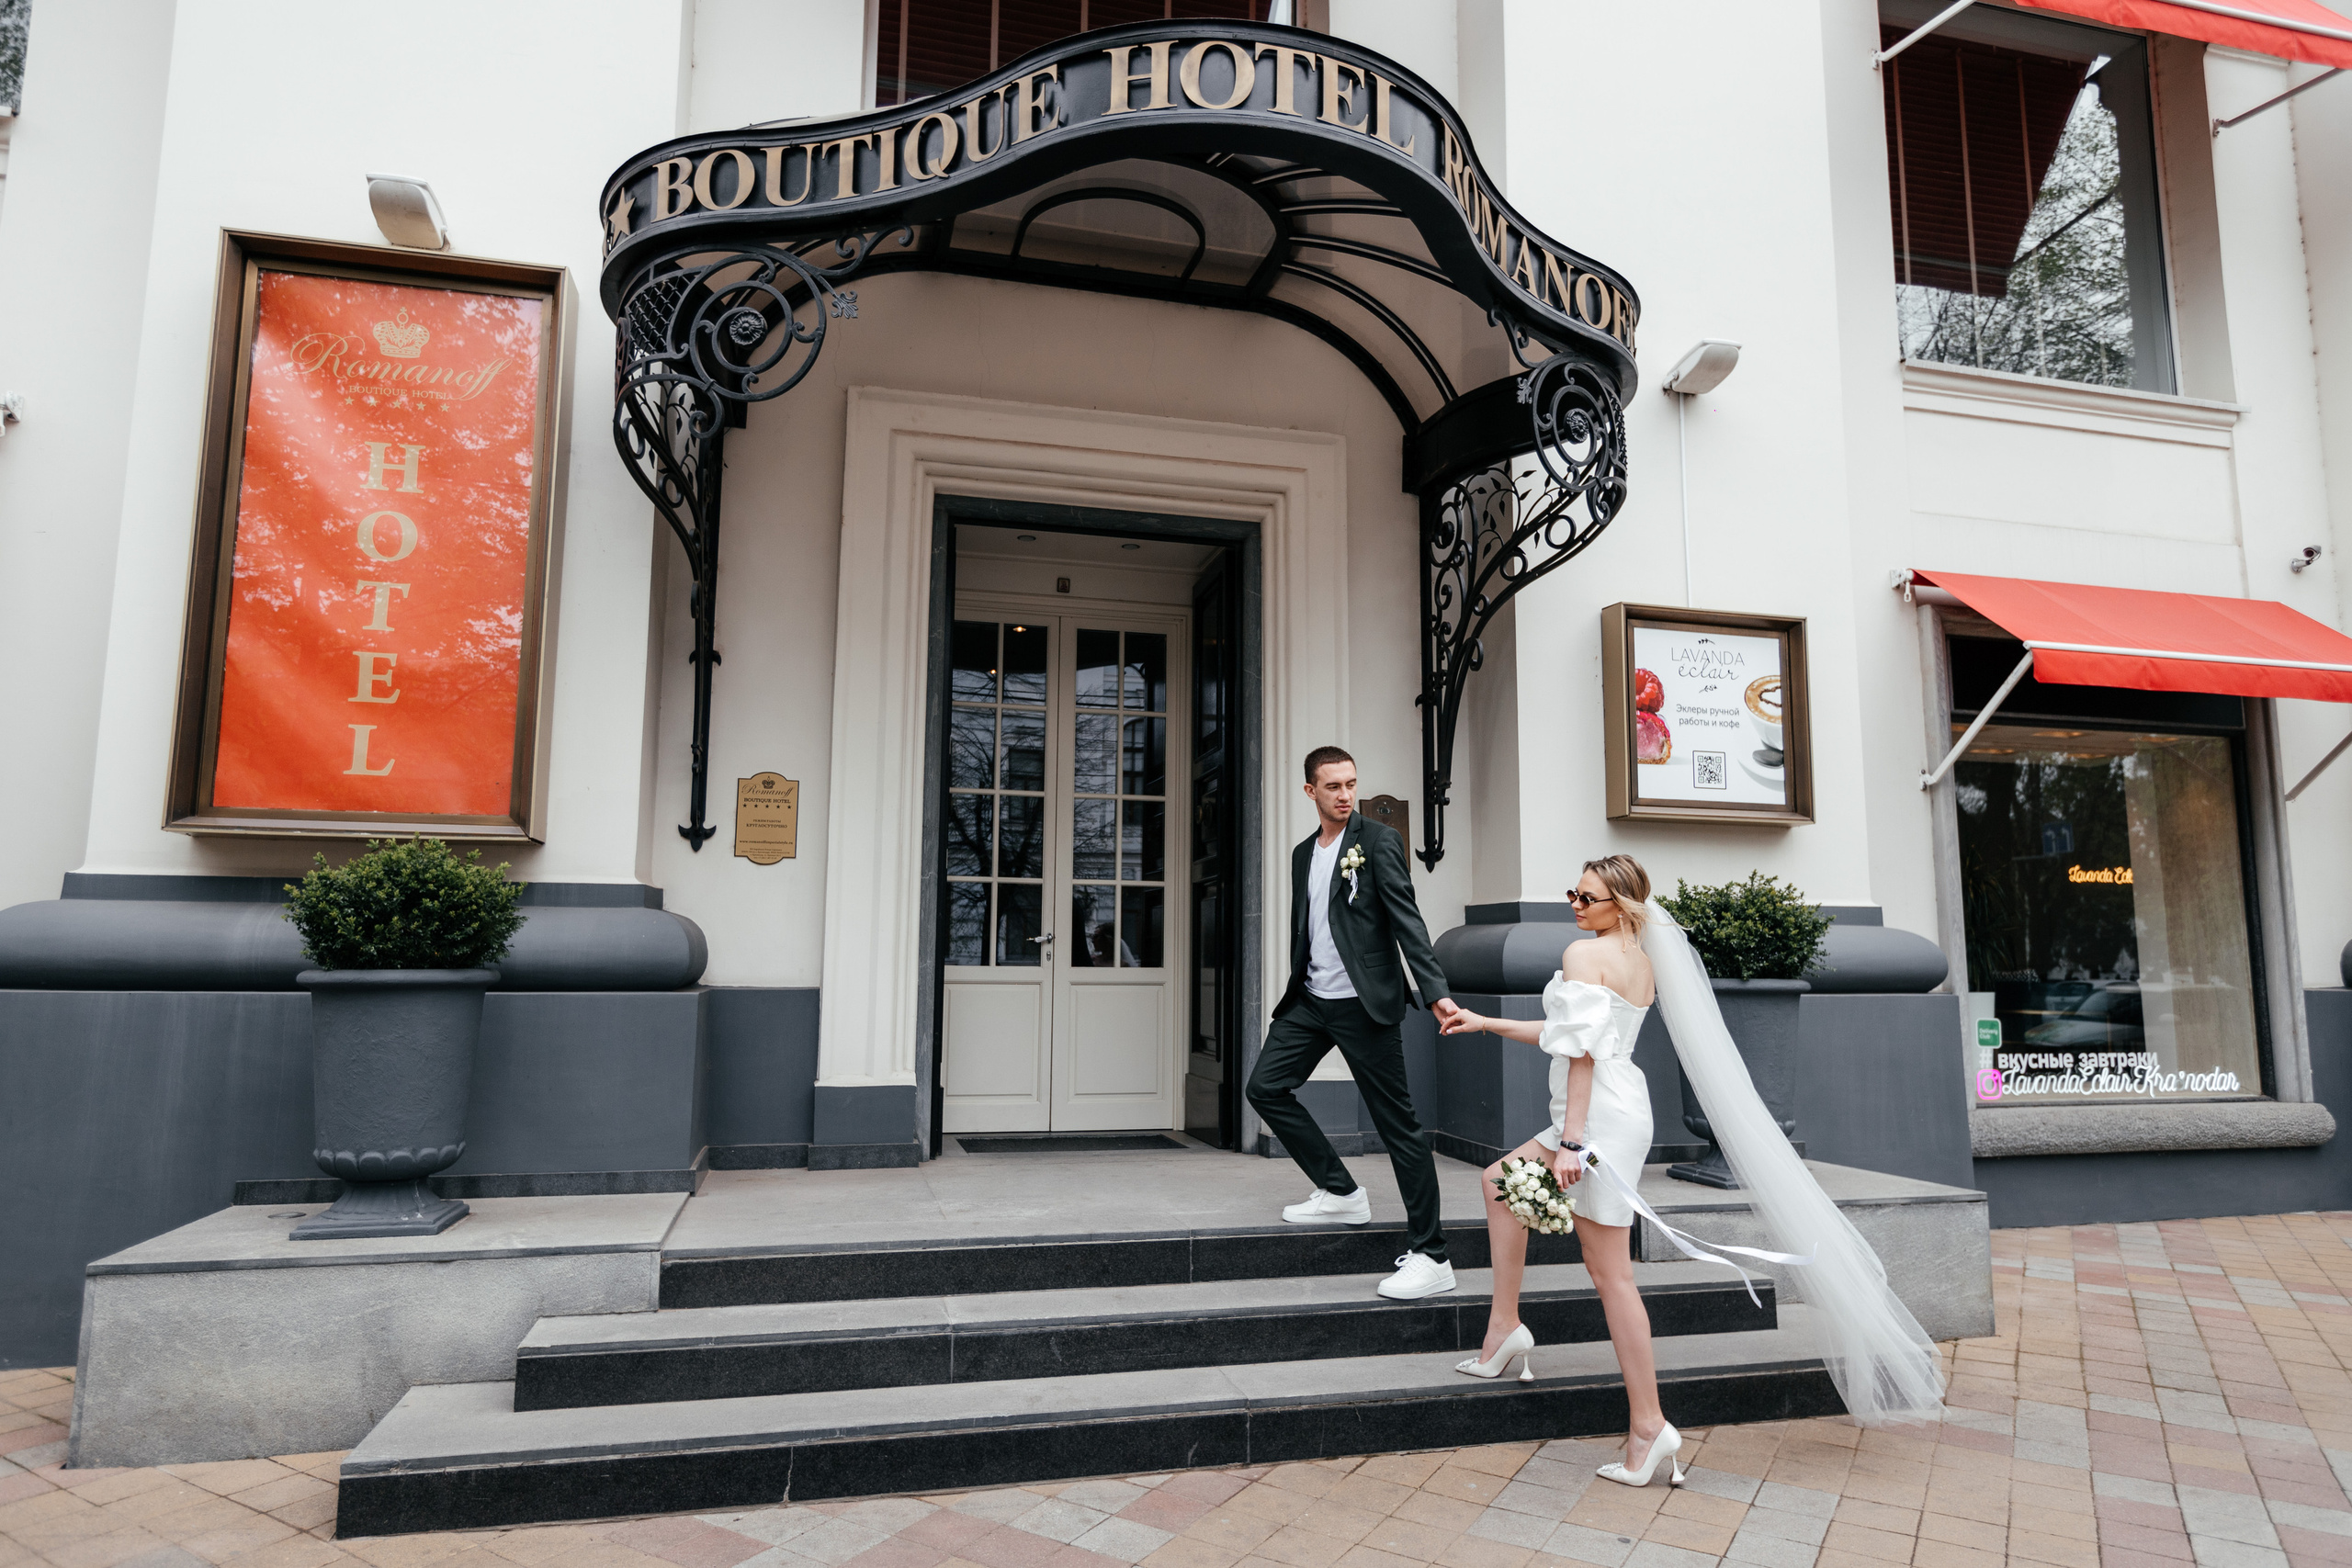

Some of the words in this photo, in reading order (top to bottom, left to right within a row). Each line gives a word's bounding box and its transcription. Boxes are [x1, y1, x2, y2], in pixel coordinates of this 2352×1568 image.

[651, 63, 1061, 222] BOUTIQUE
[1101, 39, 1415, 156] HOTEL
[288, 333, 513, 400] Romanoff
[349, 386, 408, 398] BOUTIQUE
[413, 390, 452, 400] HOTEL
[343, 441, 425, 777] HOTEL
[1670, 647, 1745, 666] LAVANDA
[1676, 704, 1708, 716] Эклеры
[1710, 706, 1740, 716] ручной
[1679, 716, 1710, 728] работы
[1719, 717, 1740, 729] кофе
[741, 784, 794, 798] Romanoff
[2068, 864, 2113, 884] Lavanda
[1979, 1028, 1998, 1036] Delivery
[2078, 1052, 2158, 1074] завтраки
